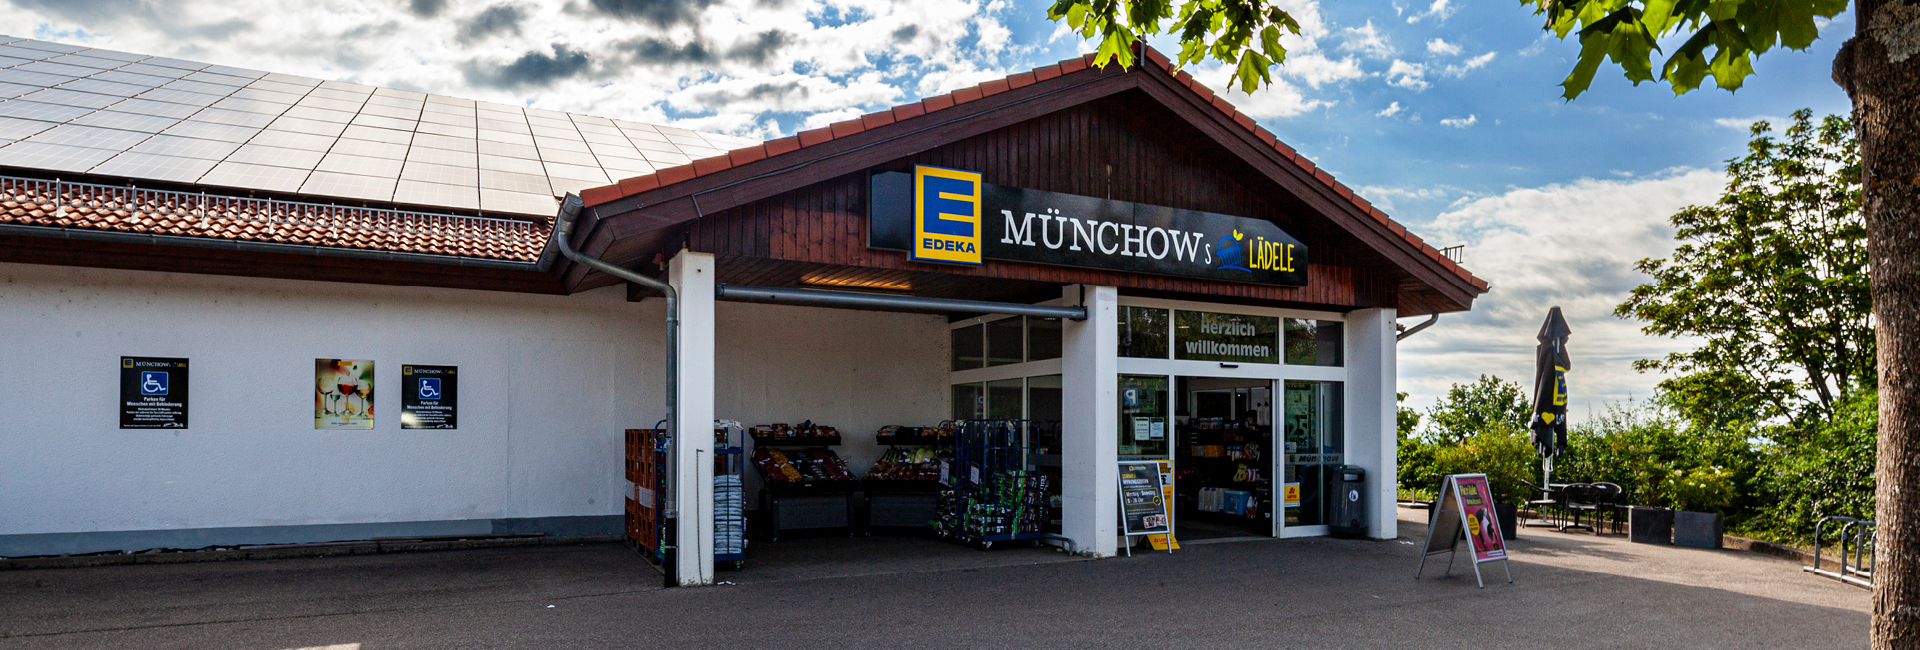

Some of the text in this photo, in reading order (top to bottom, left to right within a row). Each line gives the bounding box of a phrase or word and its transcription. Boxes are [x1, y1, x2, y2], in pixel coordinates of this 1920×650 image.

[922, 238, 976, 254] EDEKA
[1249, 238, 1295, 272] LÄDELE
[1201, 320, 1255, 337] Herzlich
[1186, 340, 1269, 358] willkommen
